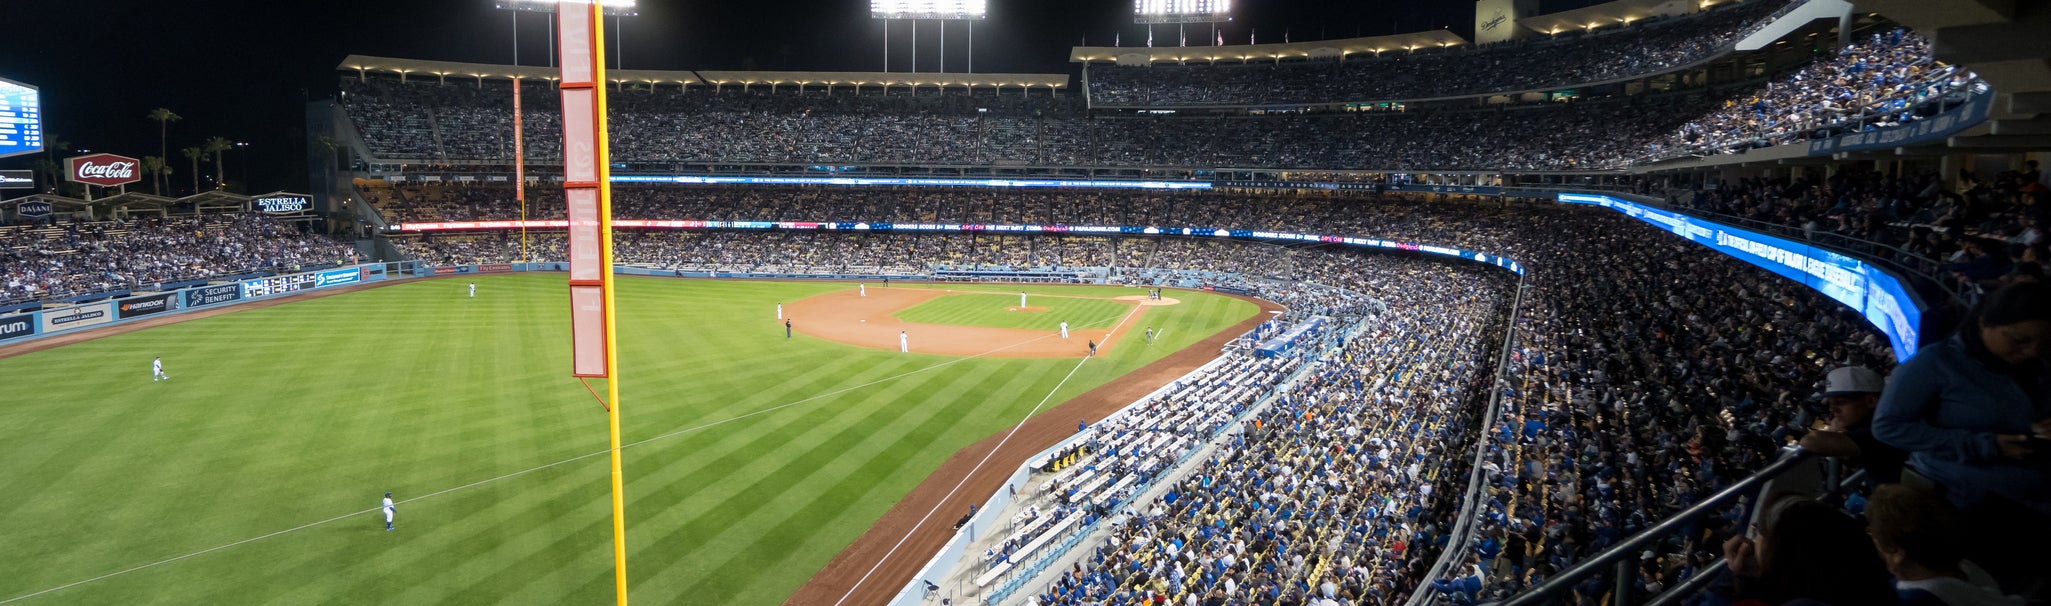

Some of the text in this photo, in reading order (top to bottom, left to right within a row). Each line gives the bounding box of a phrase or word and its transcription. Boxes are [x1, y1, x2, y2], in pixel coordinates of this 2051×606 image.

[79, 161, 135, 178] Coca-Cola
[258, 197, 307, 206] ESTRELLA
[21, 205, 50, 213] DASANI
[264, 203, 302, 212] JALISCO
[205, 285, 237, 296] SECURITY
